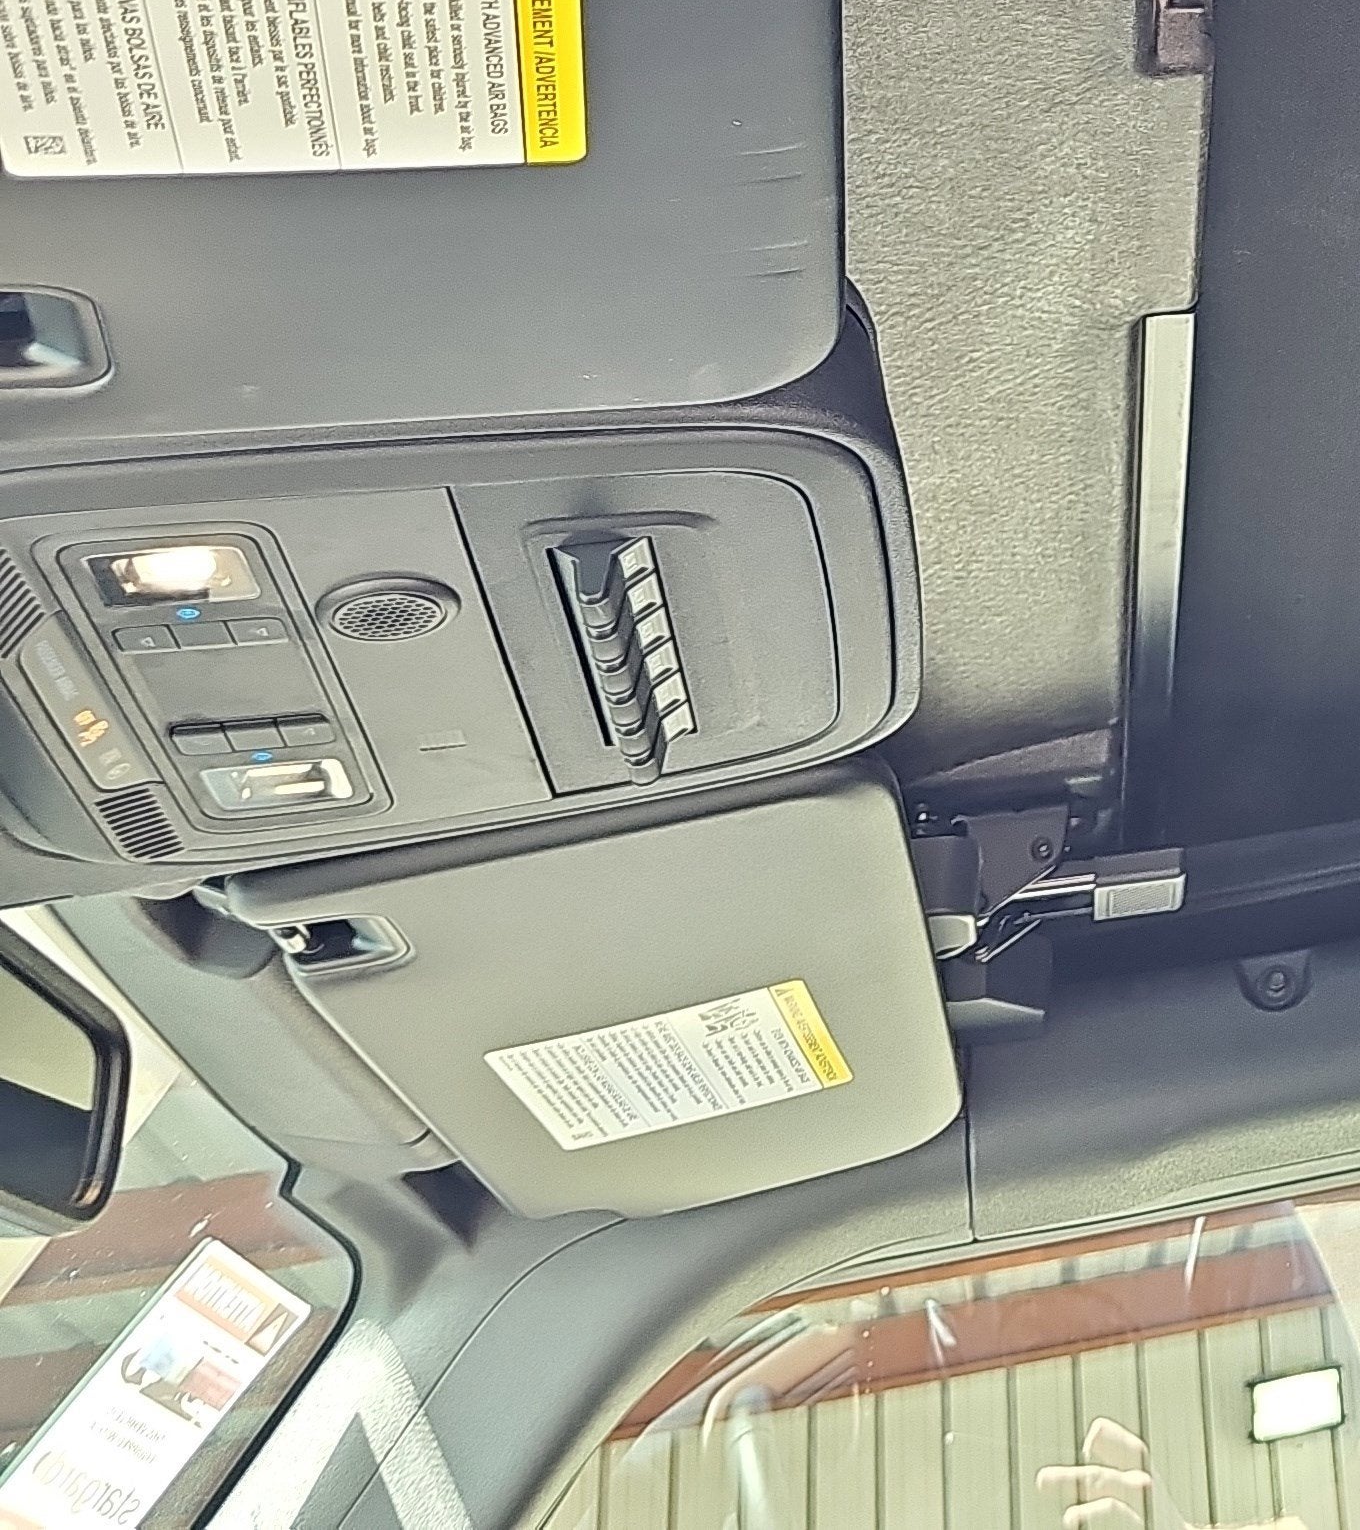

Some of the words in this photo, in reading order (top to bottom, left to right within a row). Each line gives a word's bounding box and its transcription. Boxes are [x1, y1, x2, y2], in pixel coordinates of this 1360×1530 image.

[122, 27, 154, 80] BOLSAS
[481, 12, 504, 78] ADVANCED
[135, 83, 159, 99] DE
[486, 81, 505, 100] AIR
[533, 52, 558, 148] /ADVERTENCIA
[139, 101, 166, 130] AIRE
[488, 103, 508, 134] BAGS
